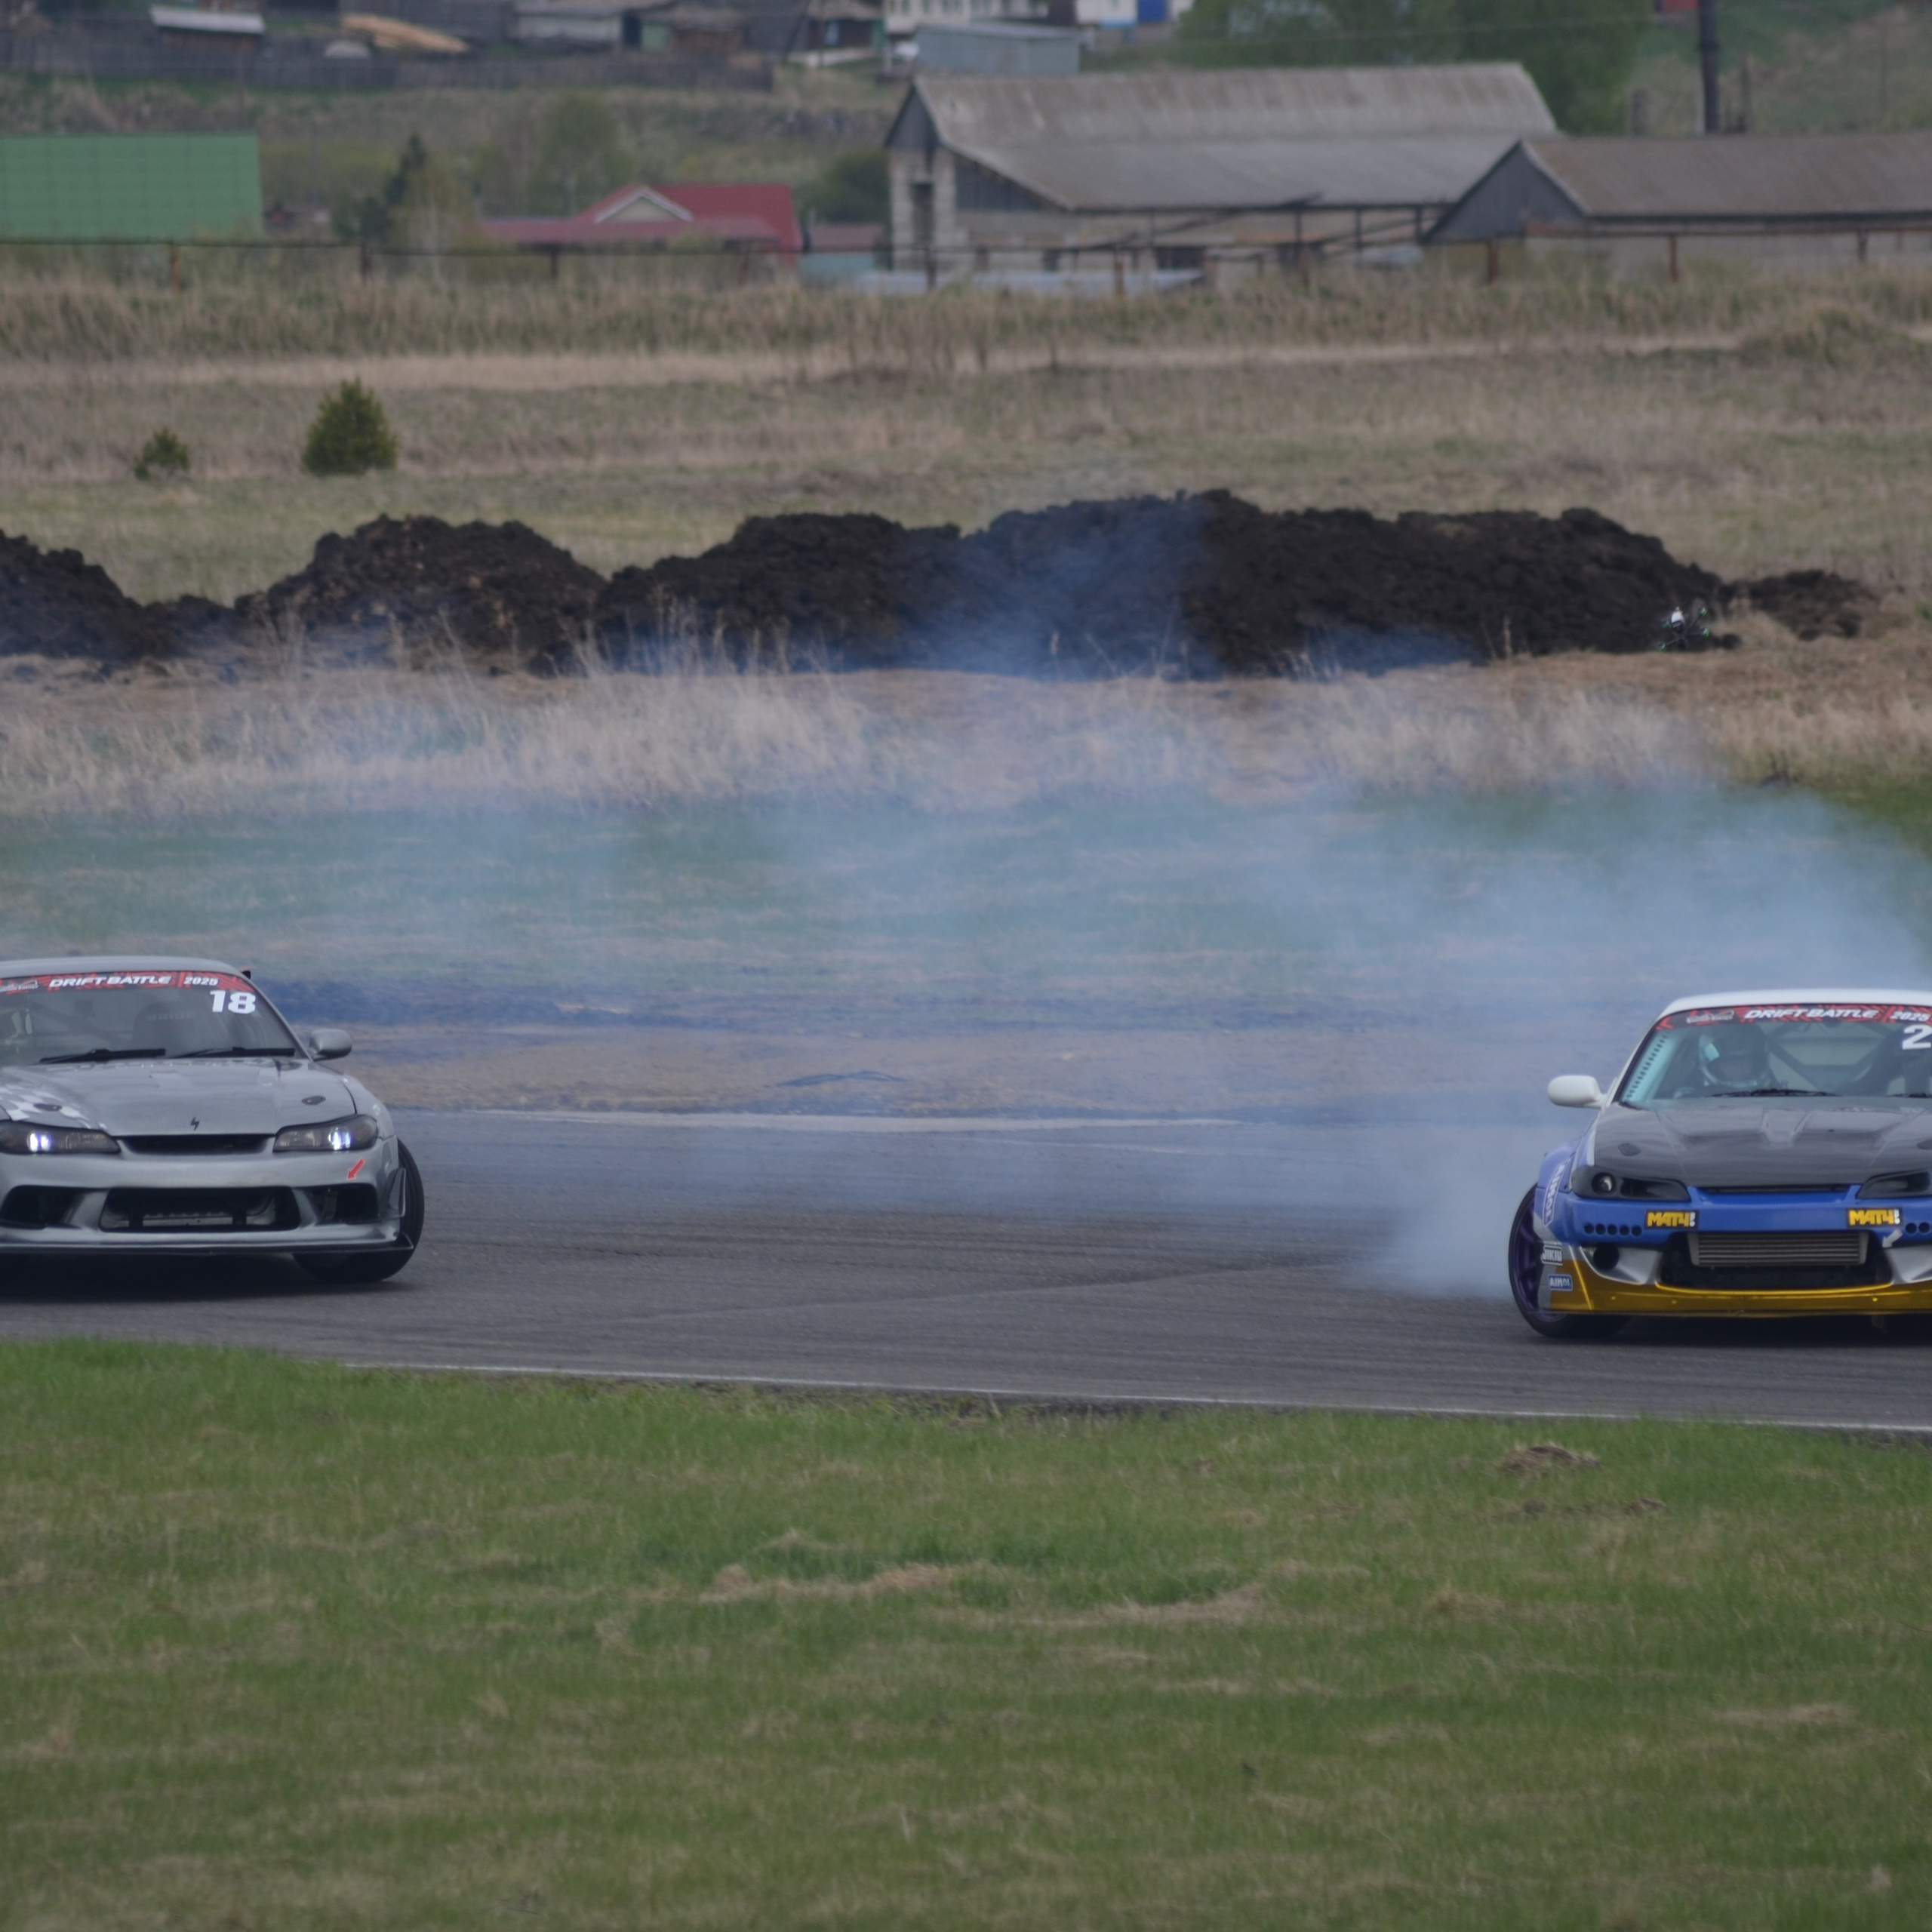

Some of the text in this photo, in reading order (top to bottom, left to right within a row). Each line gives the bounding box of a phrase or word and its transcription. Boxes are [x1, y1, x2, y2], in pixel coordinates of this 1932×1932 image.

[49, 977, 106, 987] DRIFT
[107, 976, 171, 985] BATTLE
[210, 990, 256, 1014] 18
[1744, 1009, 1808, 1019] DRIFT
[1807, 1009, 1879, 1017] BATTLE
[1890, 1011, 1930, 1021] 2025
